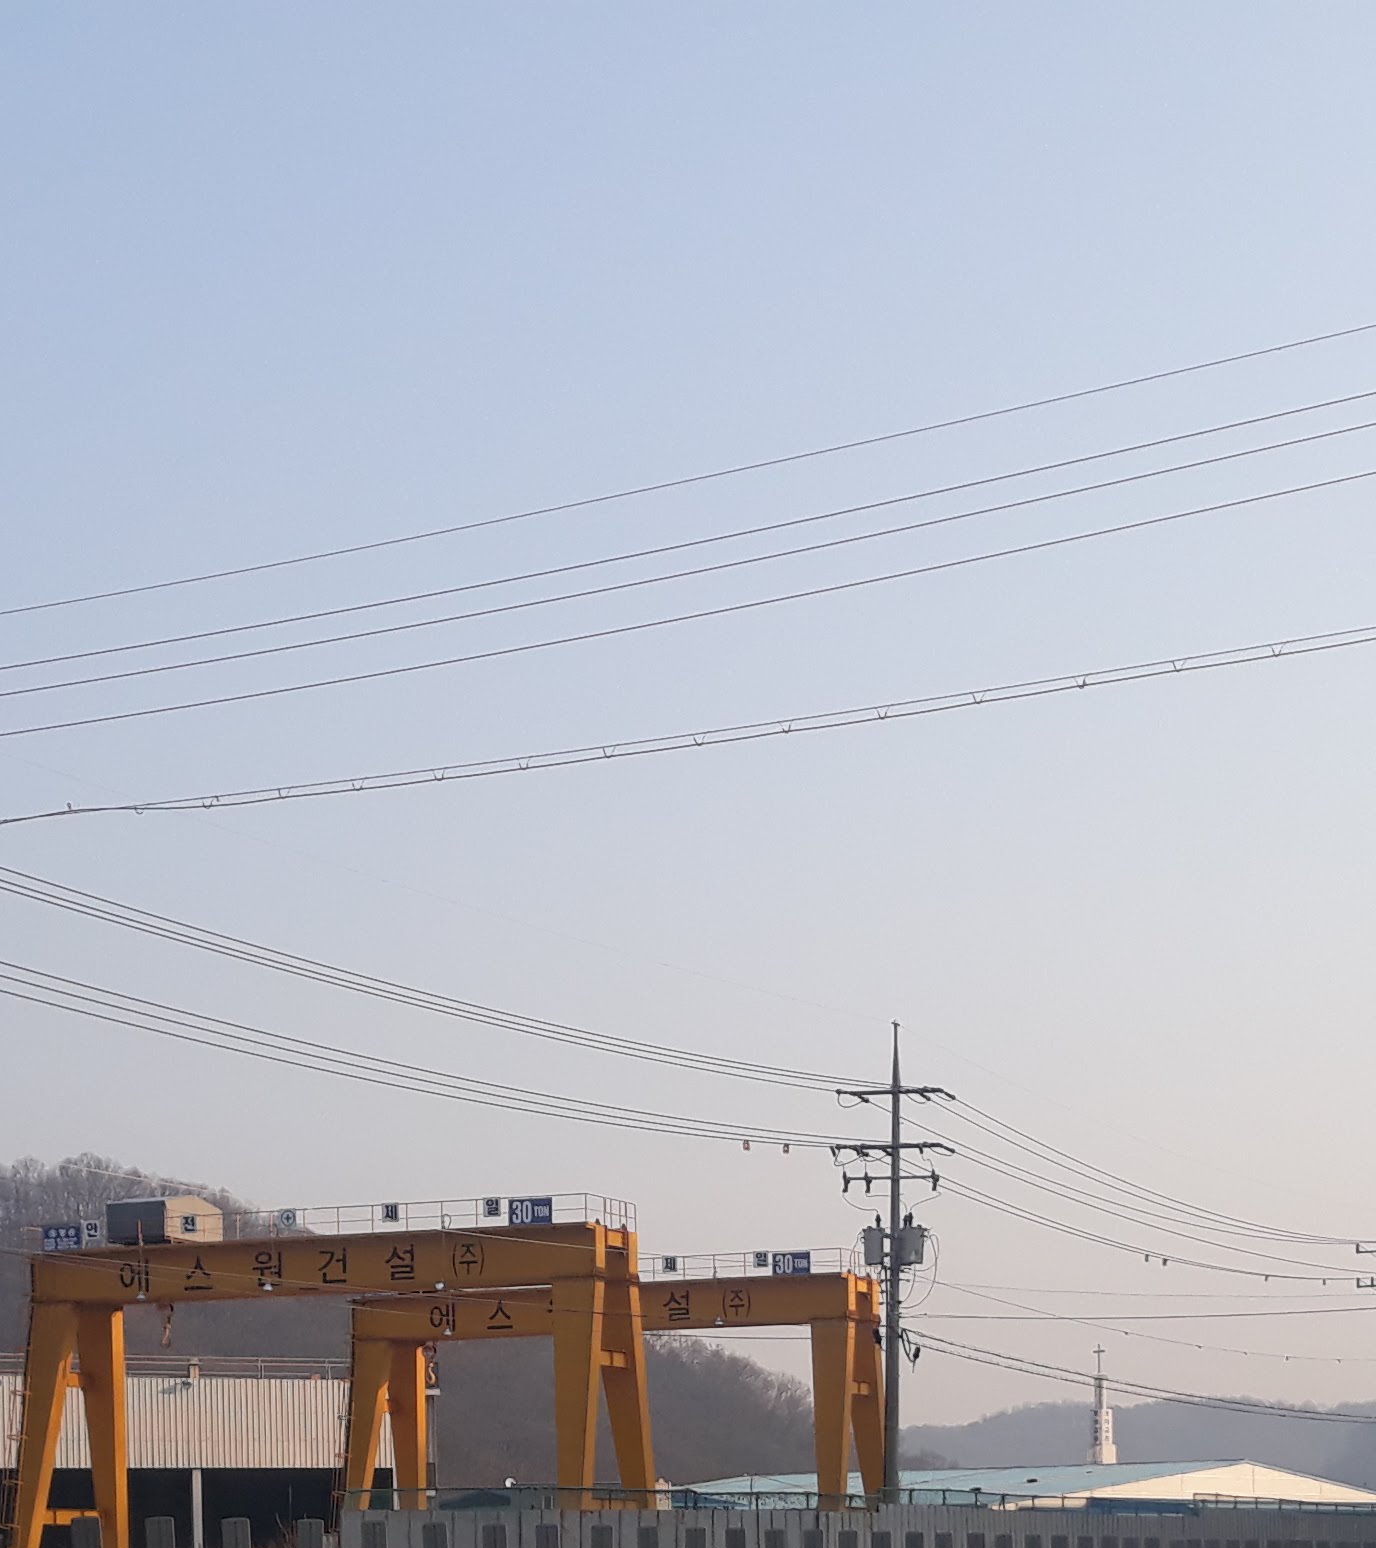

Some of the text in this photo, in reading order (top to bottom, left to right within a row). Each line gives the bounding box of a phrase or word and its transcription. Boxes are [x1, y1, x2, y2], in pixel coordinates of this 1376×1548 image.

[511, 1200, 550, 1224] 30 TON
[775, 1254, 793, 1275] 30
